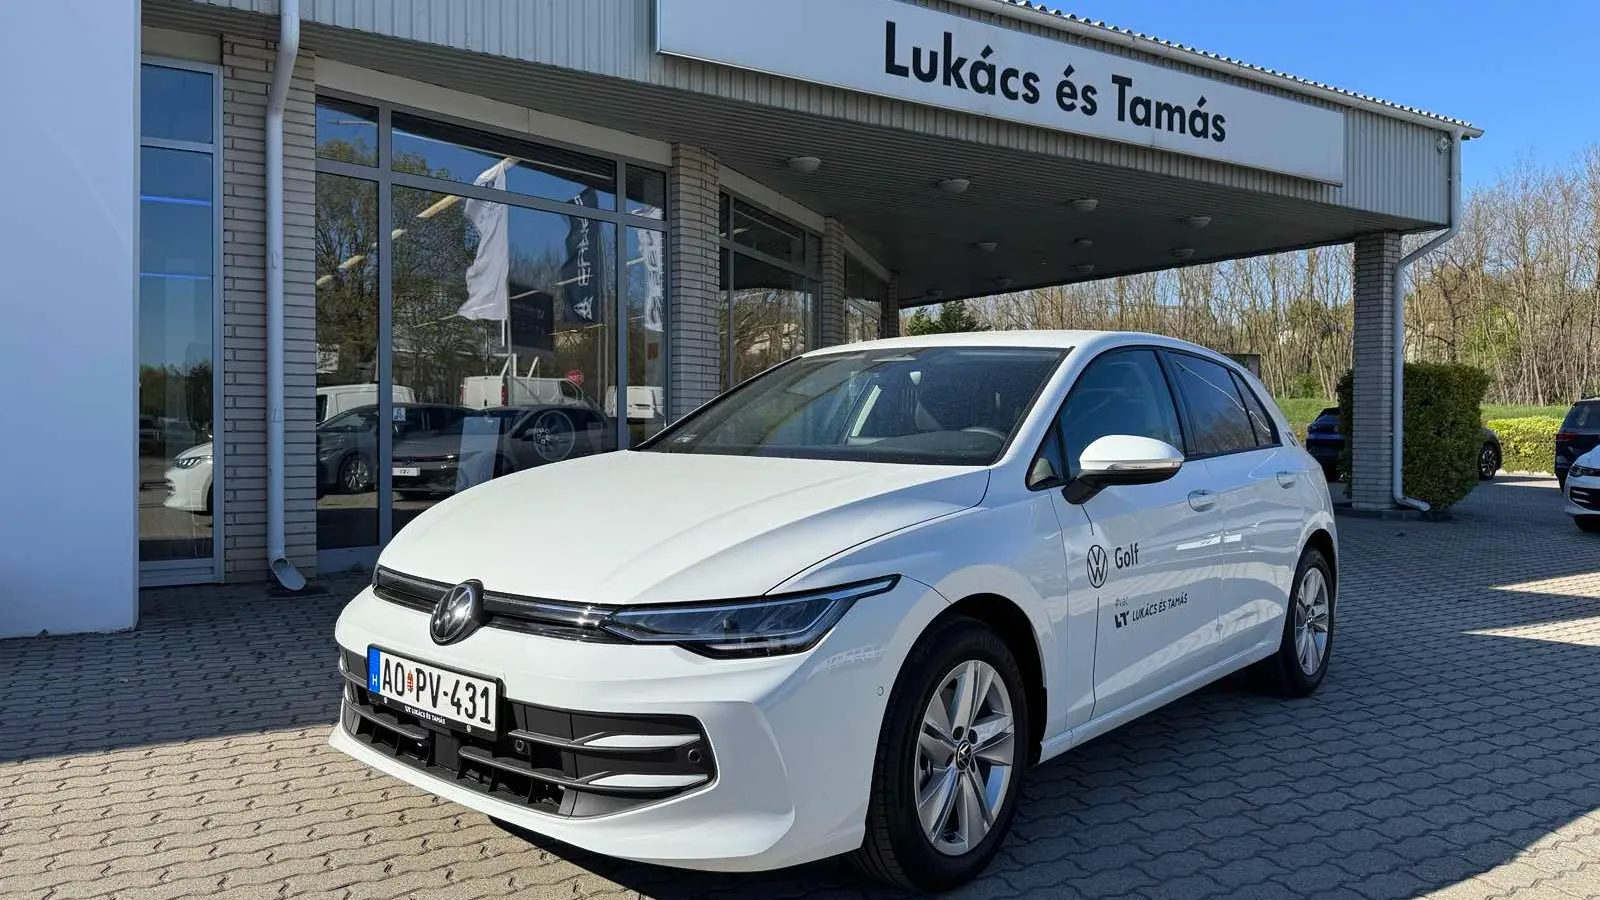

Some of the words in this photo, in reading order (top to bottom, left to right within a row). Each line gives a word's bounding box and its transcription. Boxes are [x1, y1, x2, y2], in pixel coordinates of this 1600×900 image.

[885, 20, 1040, 104] Lukács
[1055, 64, 1098, 116] és
[1111, 74, 1226, 142] Tamás
[1114, 542, 1139, 569] Golf
[1132, 602, 1158, 622] LUKÁCS
[1158, 598, 1167, 613] ÉS
[1168, 592, 1188, 609] TAMÁS
[371, 673, 378, 687] H
[382, 657, 406, 697] AO
[415, 666, 491, 725] PV-431
